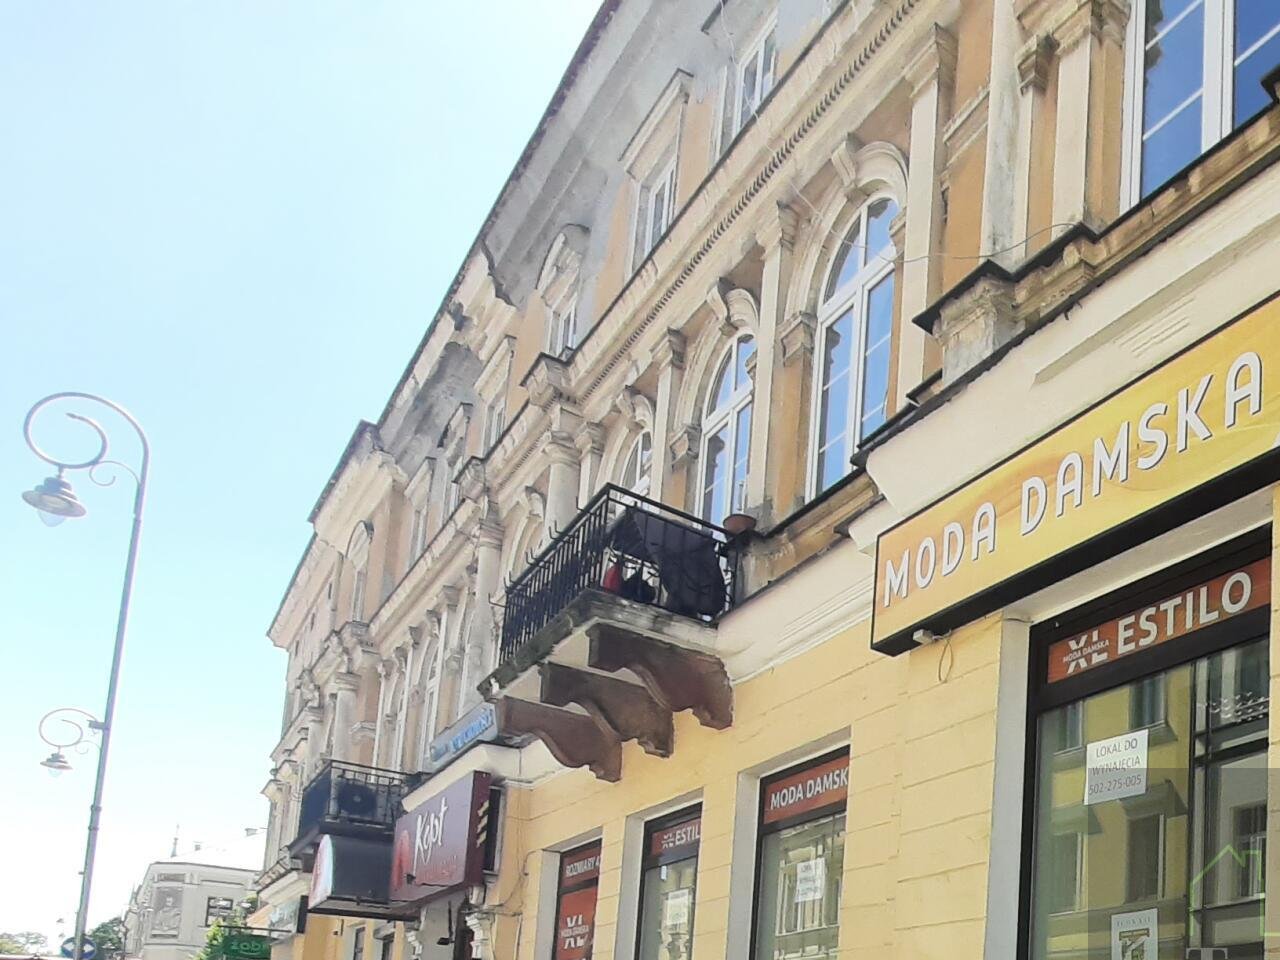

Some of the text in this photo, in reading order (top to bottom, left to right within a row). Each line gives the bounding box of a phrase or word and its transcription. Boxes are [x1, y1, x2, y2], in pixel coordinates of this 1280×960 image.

[884, 502, 996, 607] MODA
[1020, 352, 1263, 537] DAMSKA
[1117, 571, 1252, 655] ESTILO
[1096, 738, 1138, 758] LOKAL DO
[1092, 756, 1141, 777] WYNAJĘCIA
[770, 766, 849, 811] MODA DAMSK
[1088, 774, 1142, 796] 502-275-005
[675, 823, 701, 846] ESTIL
